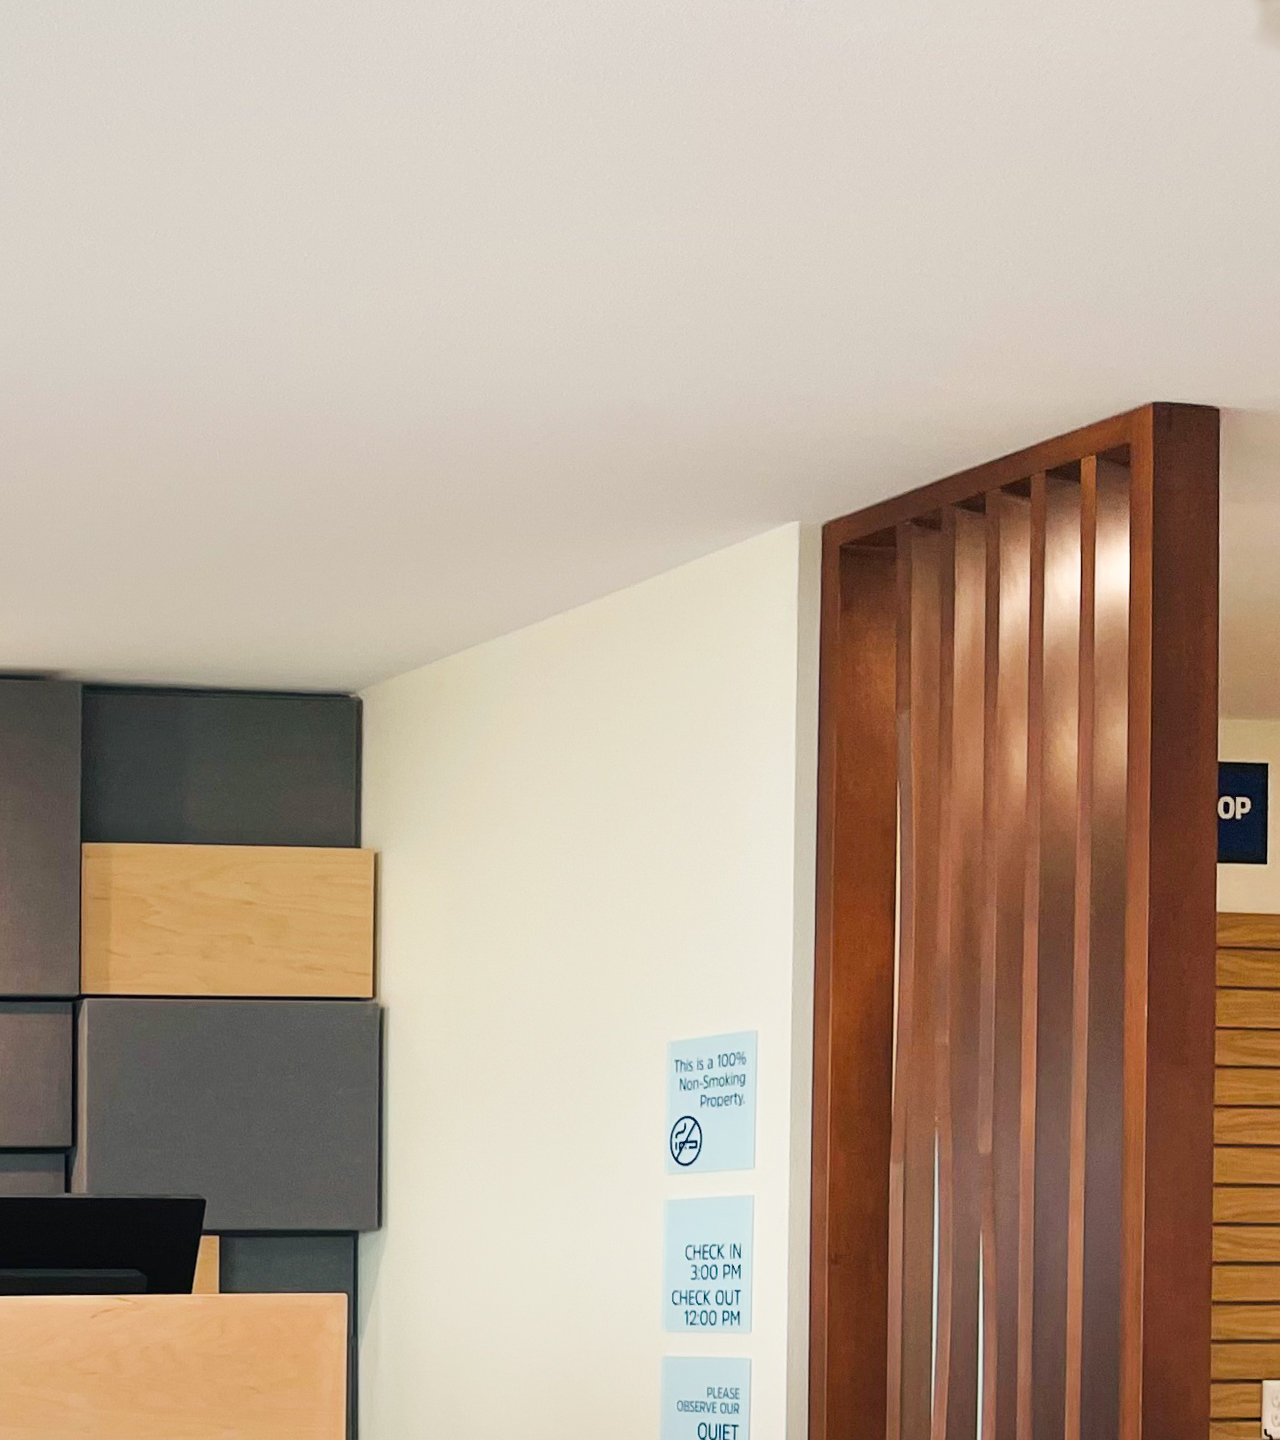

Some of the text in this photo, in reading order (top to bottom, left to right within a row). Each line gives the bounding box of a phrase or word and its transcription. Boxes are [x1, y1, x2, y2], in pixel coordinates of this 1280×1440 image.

[674, 1052, 746, 1072] This is a 100%
[679, 1073, 746, 1091] Non-Smoking
[685, 1243, 742, 1260] CHECK IN
[690, 1264, 742, 1280] 3:00 PM
[671, 1289, 742, 1306] CHECK OUT
[684, 1310, 741, 1326] 12:00 PM
[706, 1387, 740, 1400] PLEASE
[676, 1400, 740, 1414] OBSERVE OUR
